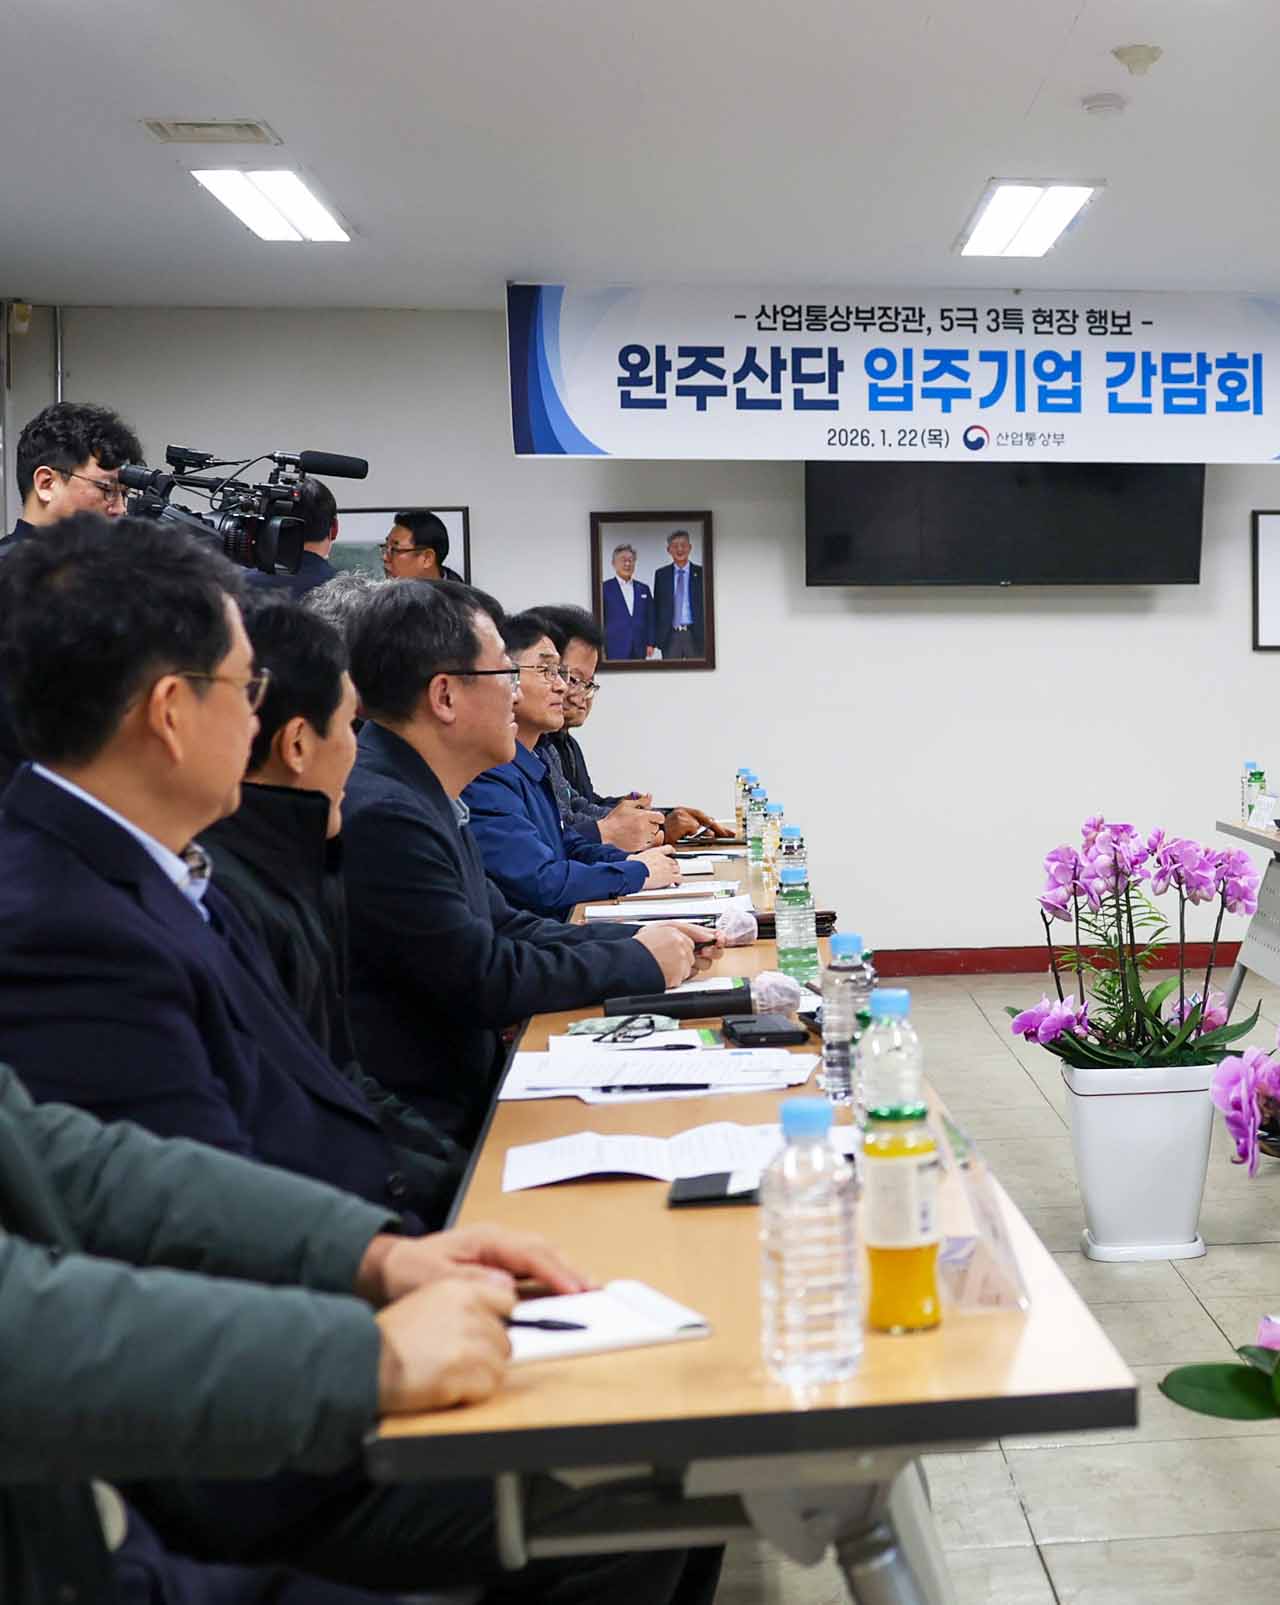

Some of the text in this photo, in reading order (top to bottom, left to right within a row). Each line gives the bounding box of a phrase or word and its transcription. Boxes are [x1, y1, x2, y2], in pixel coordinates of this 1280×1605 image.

[755, 304, 932, 336] 산업통상부장관,
[940, 308, 978, 334] 5극
[986, 308, 1024, 334] 3특
[1032, 308, 1079, 335] 현장
[1086, 309, 1133, 336] 행보
[617, 344, 1263, 415] 완주산단 입주기업 간담회
[996, 432, 1065, 447] 산업통상부
